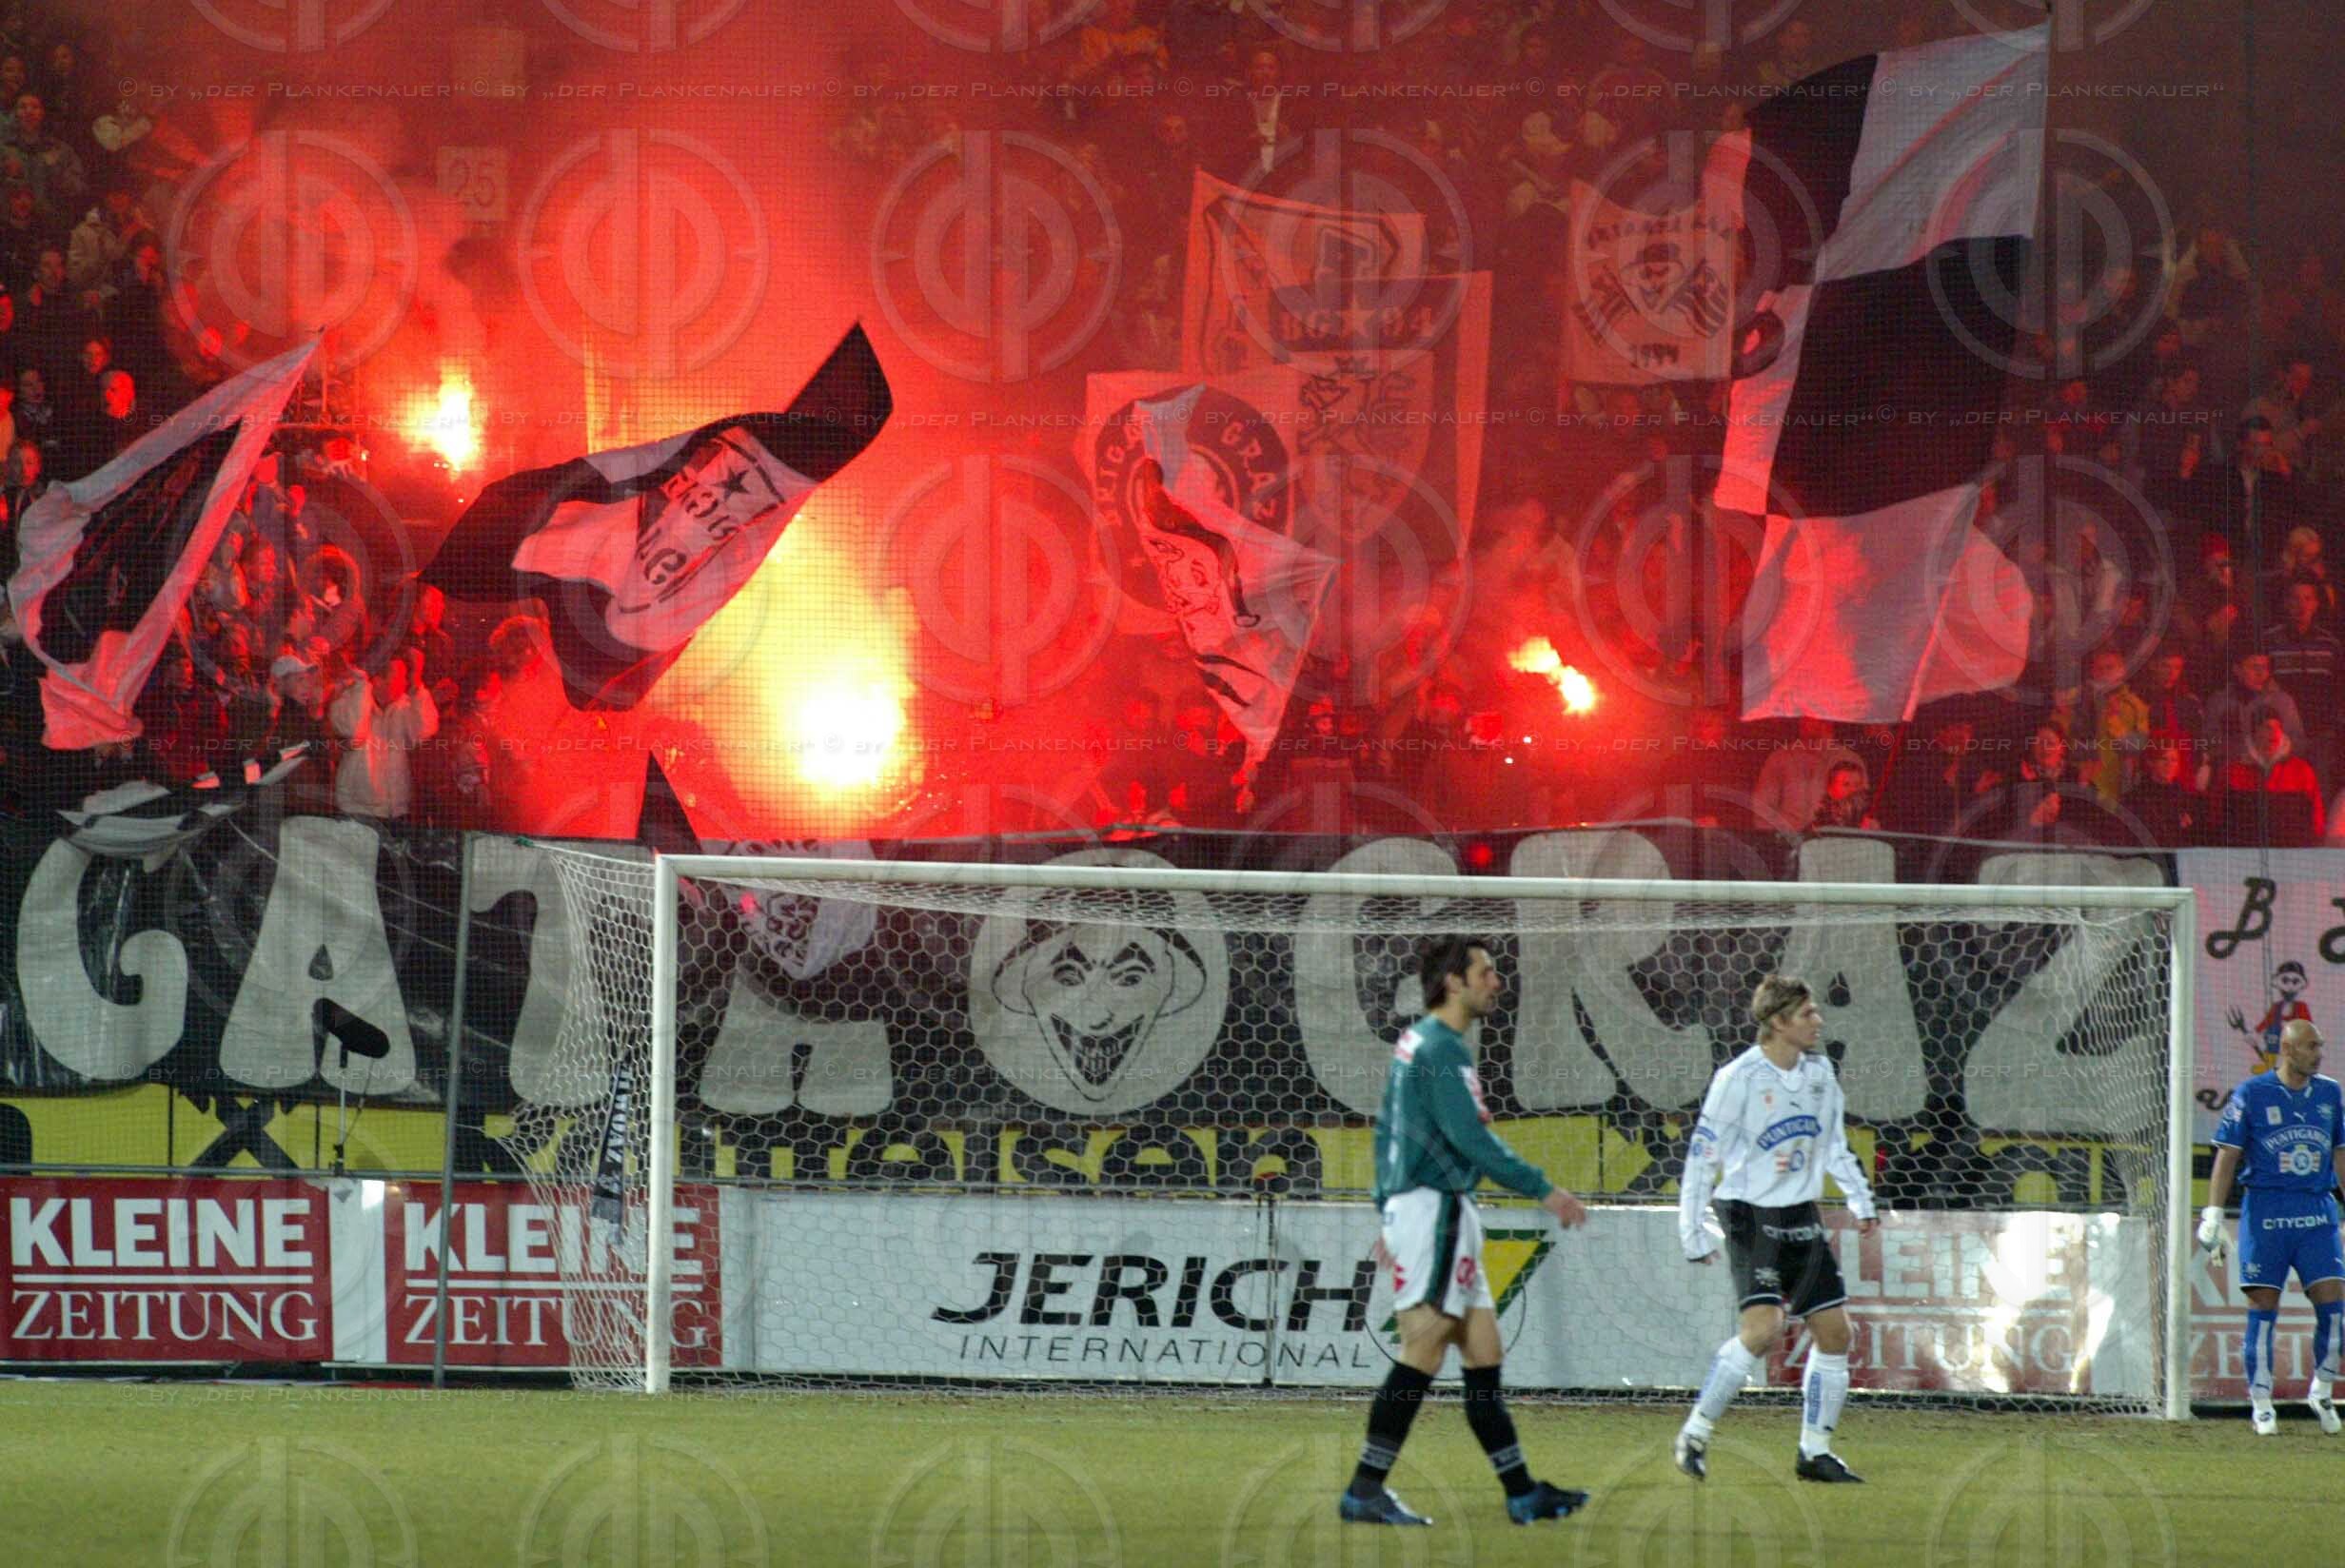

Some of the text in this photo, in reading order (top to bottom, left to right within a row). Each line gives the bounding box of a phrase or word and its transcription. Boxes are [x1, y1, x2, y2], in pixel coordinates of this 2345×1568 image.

[10, 1197, 313, 1267] KLEINE
[2261, 1214, 2329, 1230] CITYCOM
[10, 1290, 319, 1341] ZEITUNG
[930, 1251, 1378, 1332] JERICH
[959, 1334, 1372, 1368] INTERNATIONAL
